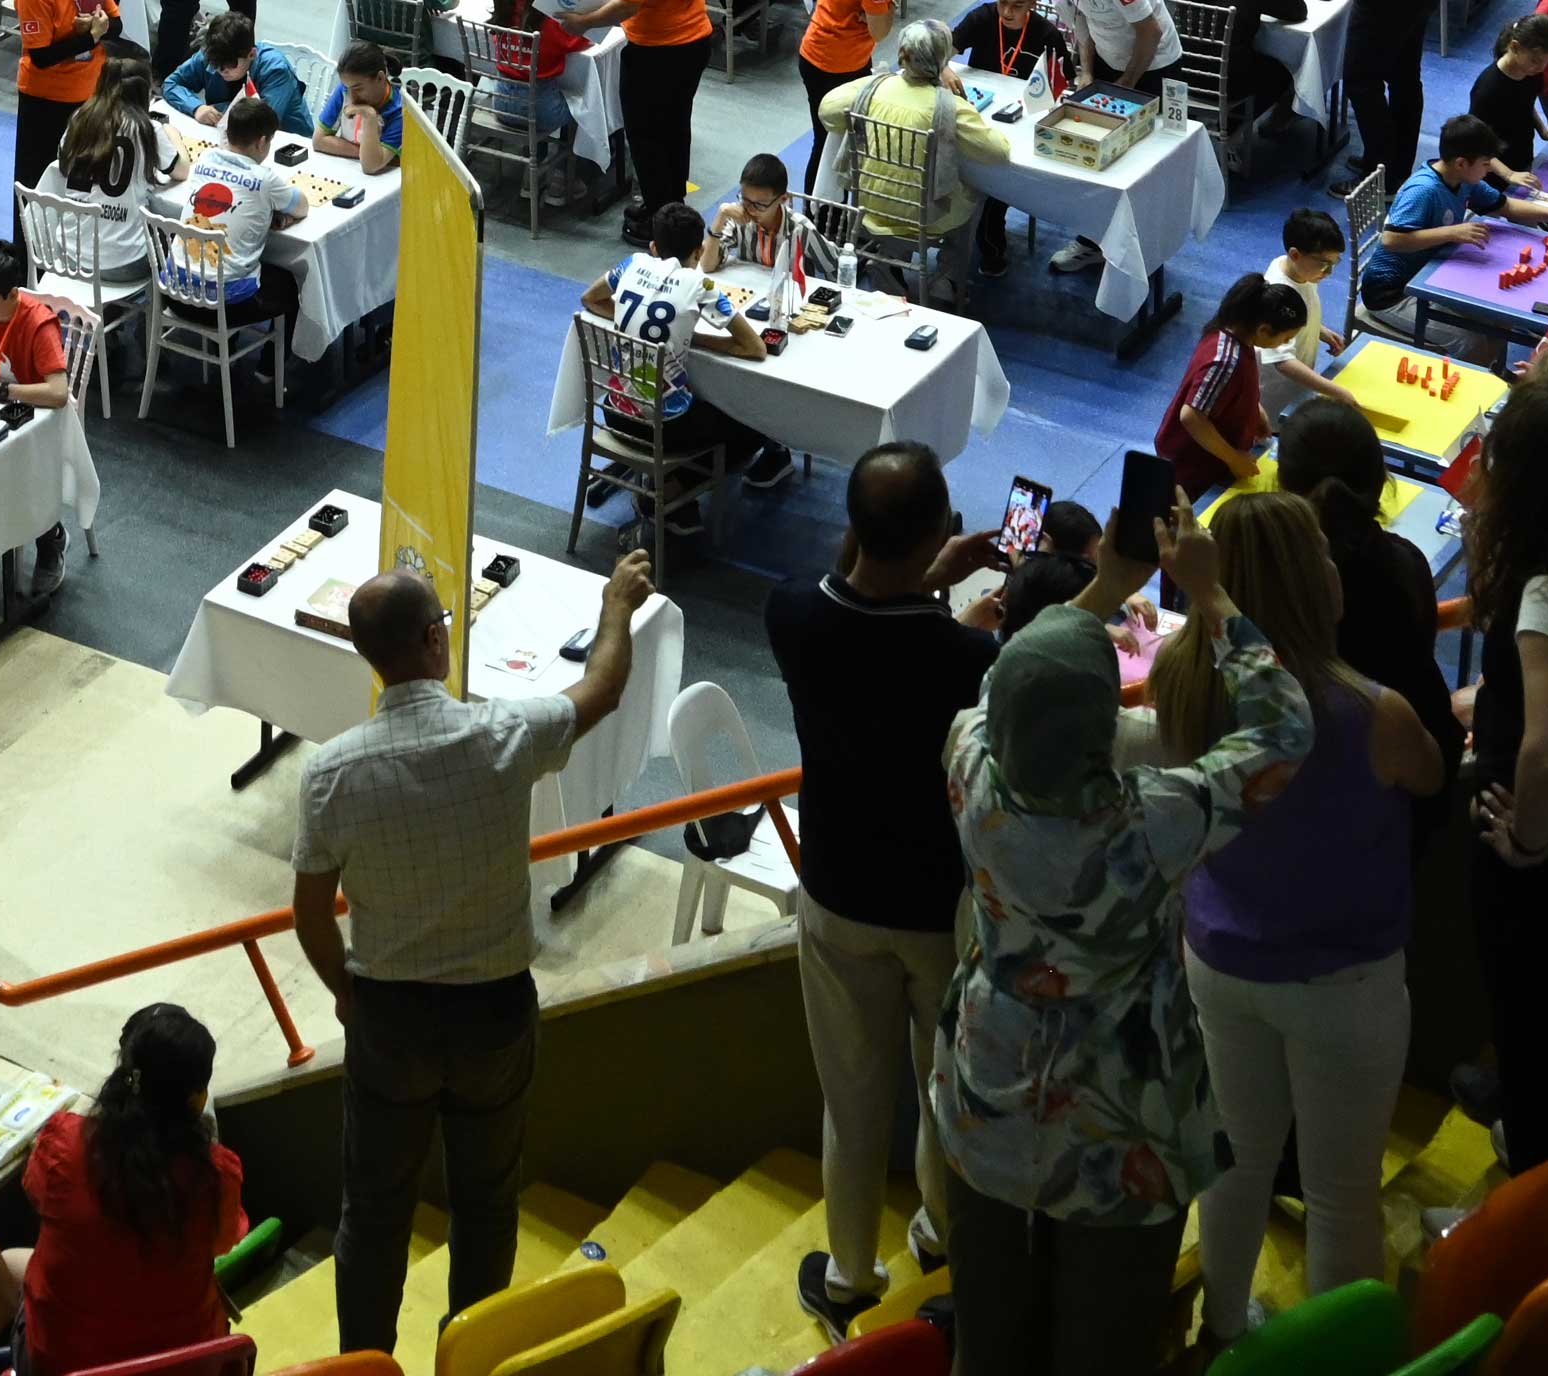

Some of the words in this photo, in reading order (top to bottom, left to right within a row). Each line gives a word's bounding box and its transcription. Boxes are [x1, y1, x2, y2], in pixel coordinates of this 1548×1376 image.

[1168, 106, 1183, 122] 28
[220, 169, 262, 192] Koleji
[618, 289, 676, 345] 78
